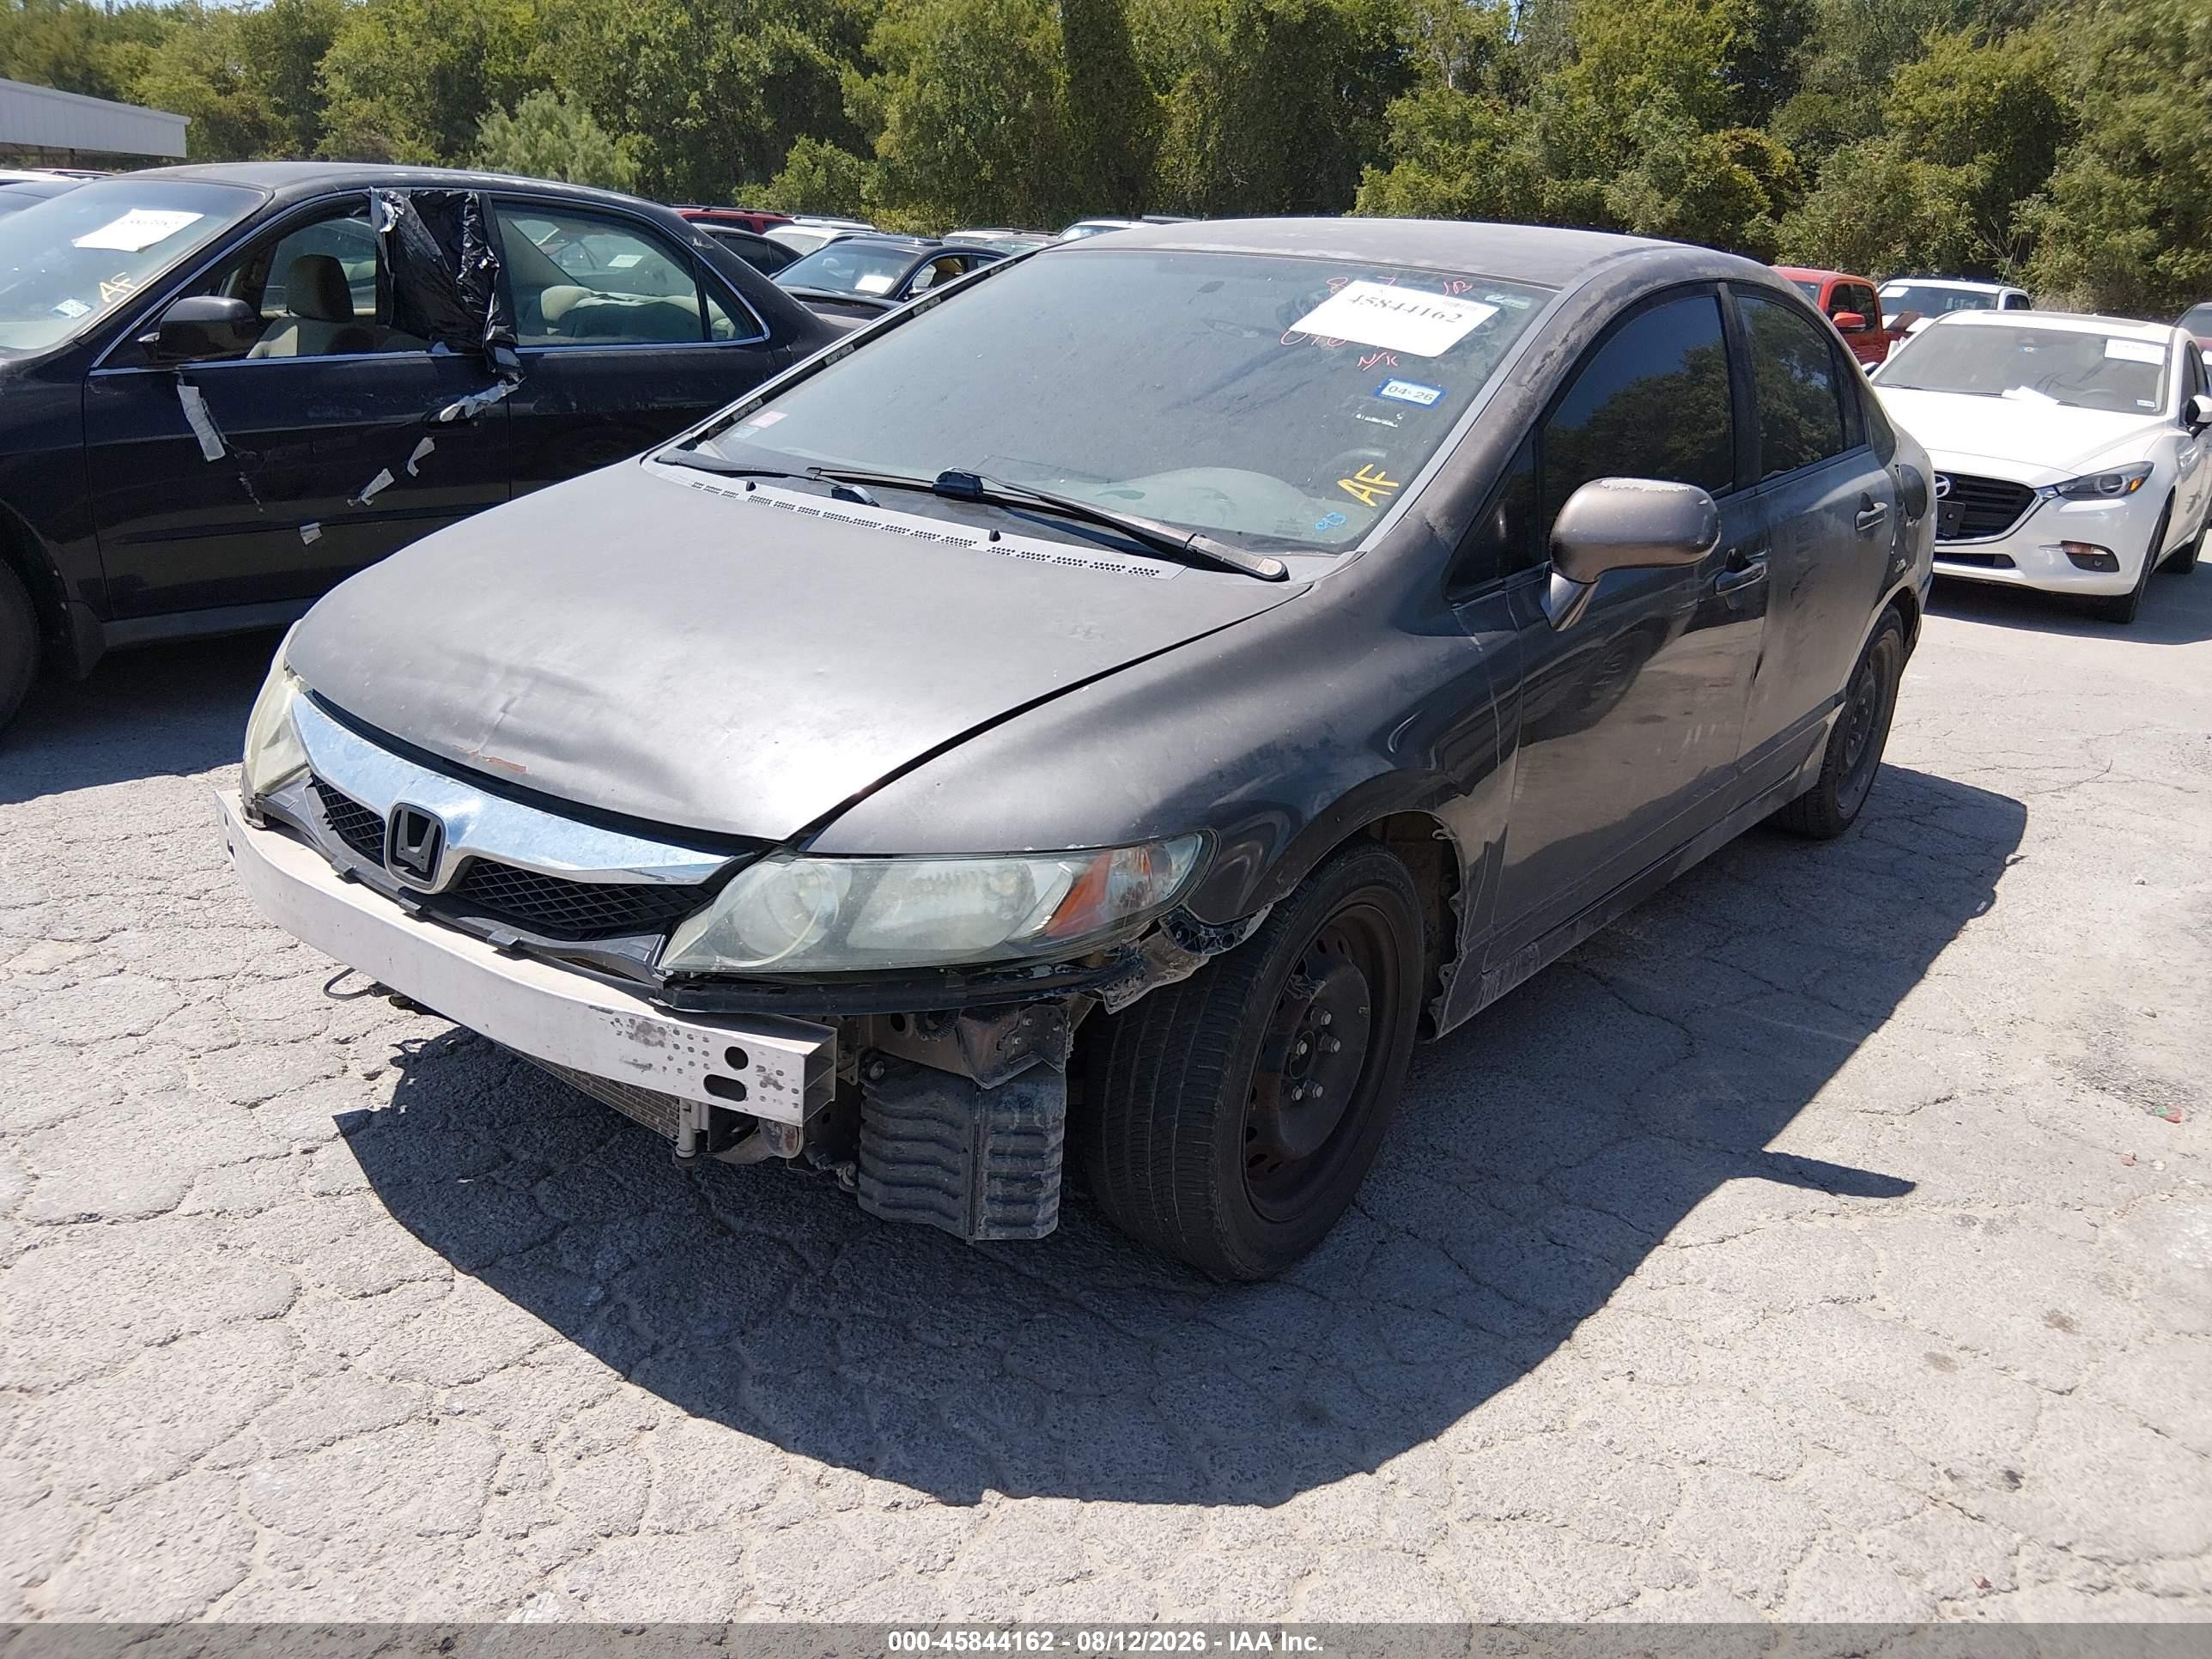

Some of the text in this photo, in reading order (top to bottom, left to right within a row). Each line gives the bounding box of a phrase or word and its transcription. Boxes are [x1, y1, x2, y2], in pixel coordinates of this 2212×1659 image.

[100, 272, 135, 303] AF
[1347, 294, 1463, 324] 45844162
[1337, 464, 1400, 507] AF
